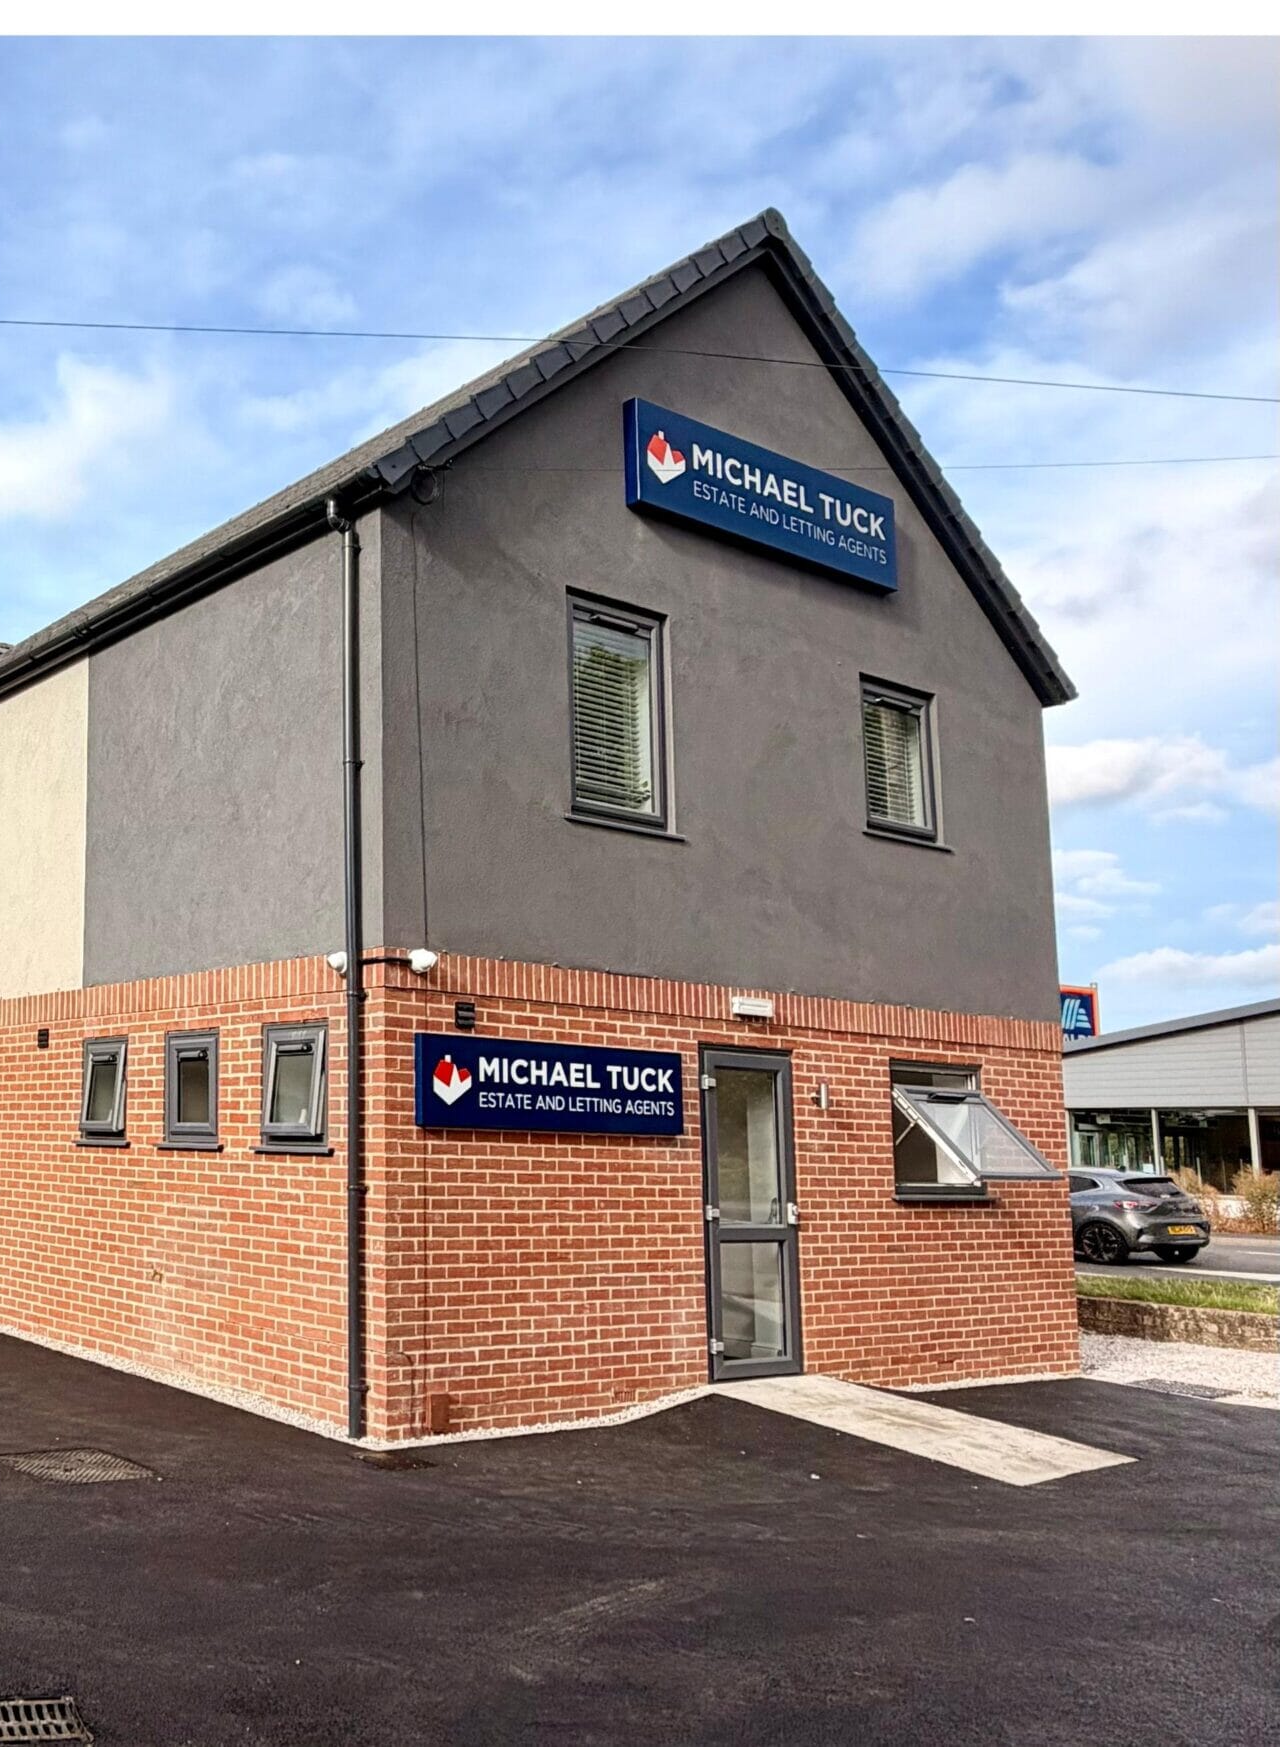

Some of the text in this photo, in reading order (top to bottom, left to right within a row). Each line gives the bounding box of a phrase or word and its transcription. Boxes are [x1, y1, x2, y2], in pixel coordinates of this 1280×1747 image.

[692, 443, 886, 541] MICHAEL TUCK
[693, 480, 887, 565] ESTATE AND LETTING AGENTS
[478, 1056, 674, 1093] MICHAEL TUCK
[478, 1092, 675, 1117] ESTATE AND LETTING AGENTS
